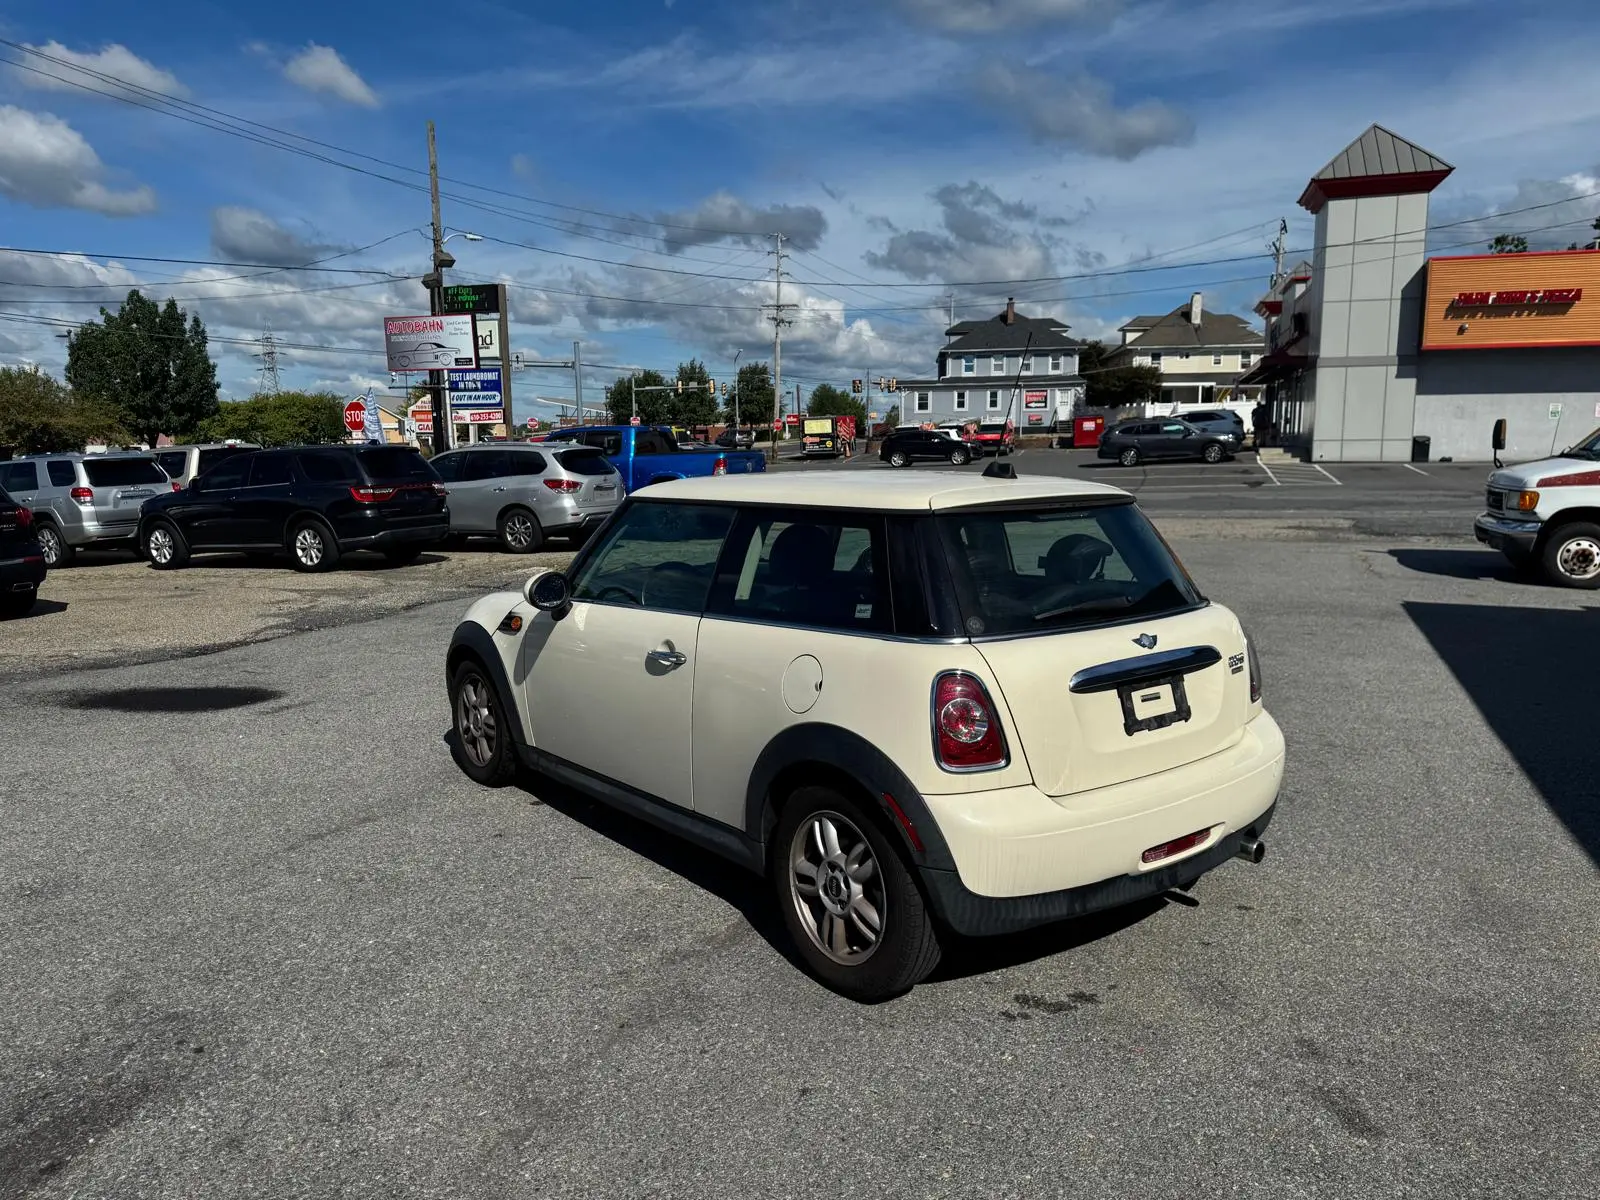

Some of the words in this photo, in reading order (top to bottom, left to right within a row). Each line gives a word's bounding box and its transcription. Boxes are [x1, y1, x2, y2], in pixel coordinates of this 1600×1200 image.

[387, 320, 444, 334] AUTOBAHN
[463, 371, 499, 381] LAUNDROMAT
[345, 410, 365, 422] STOP
